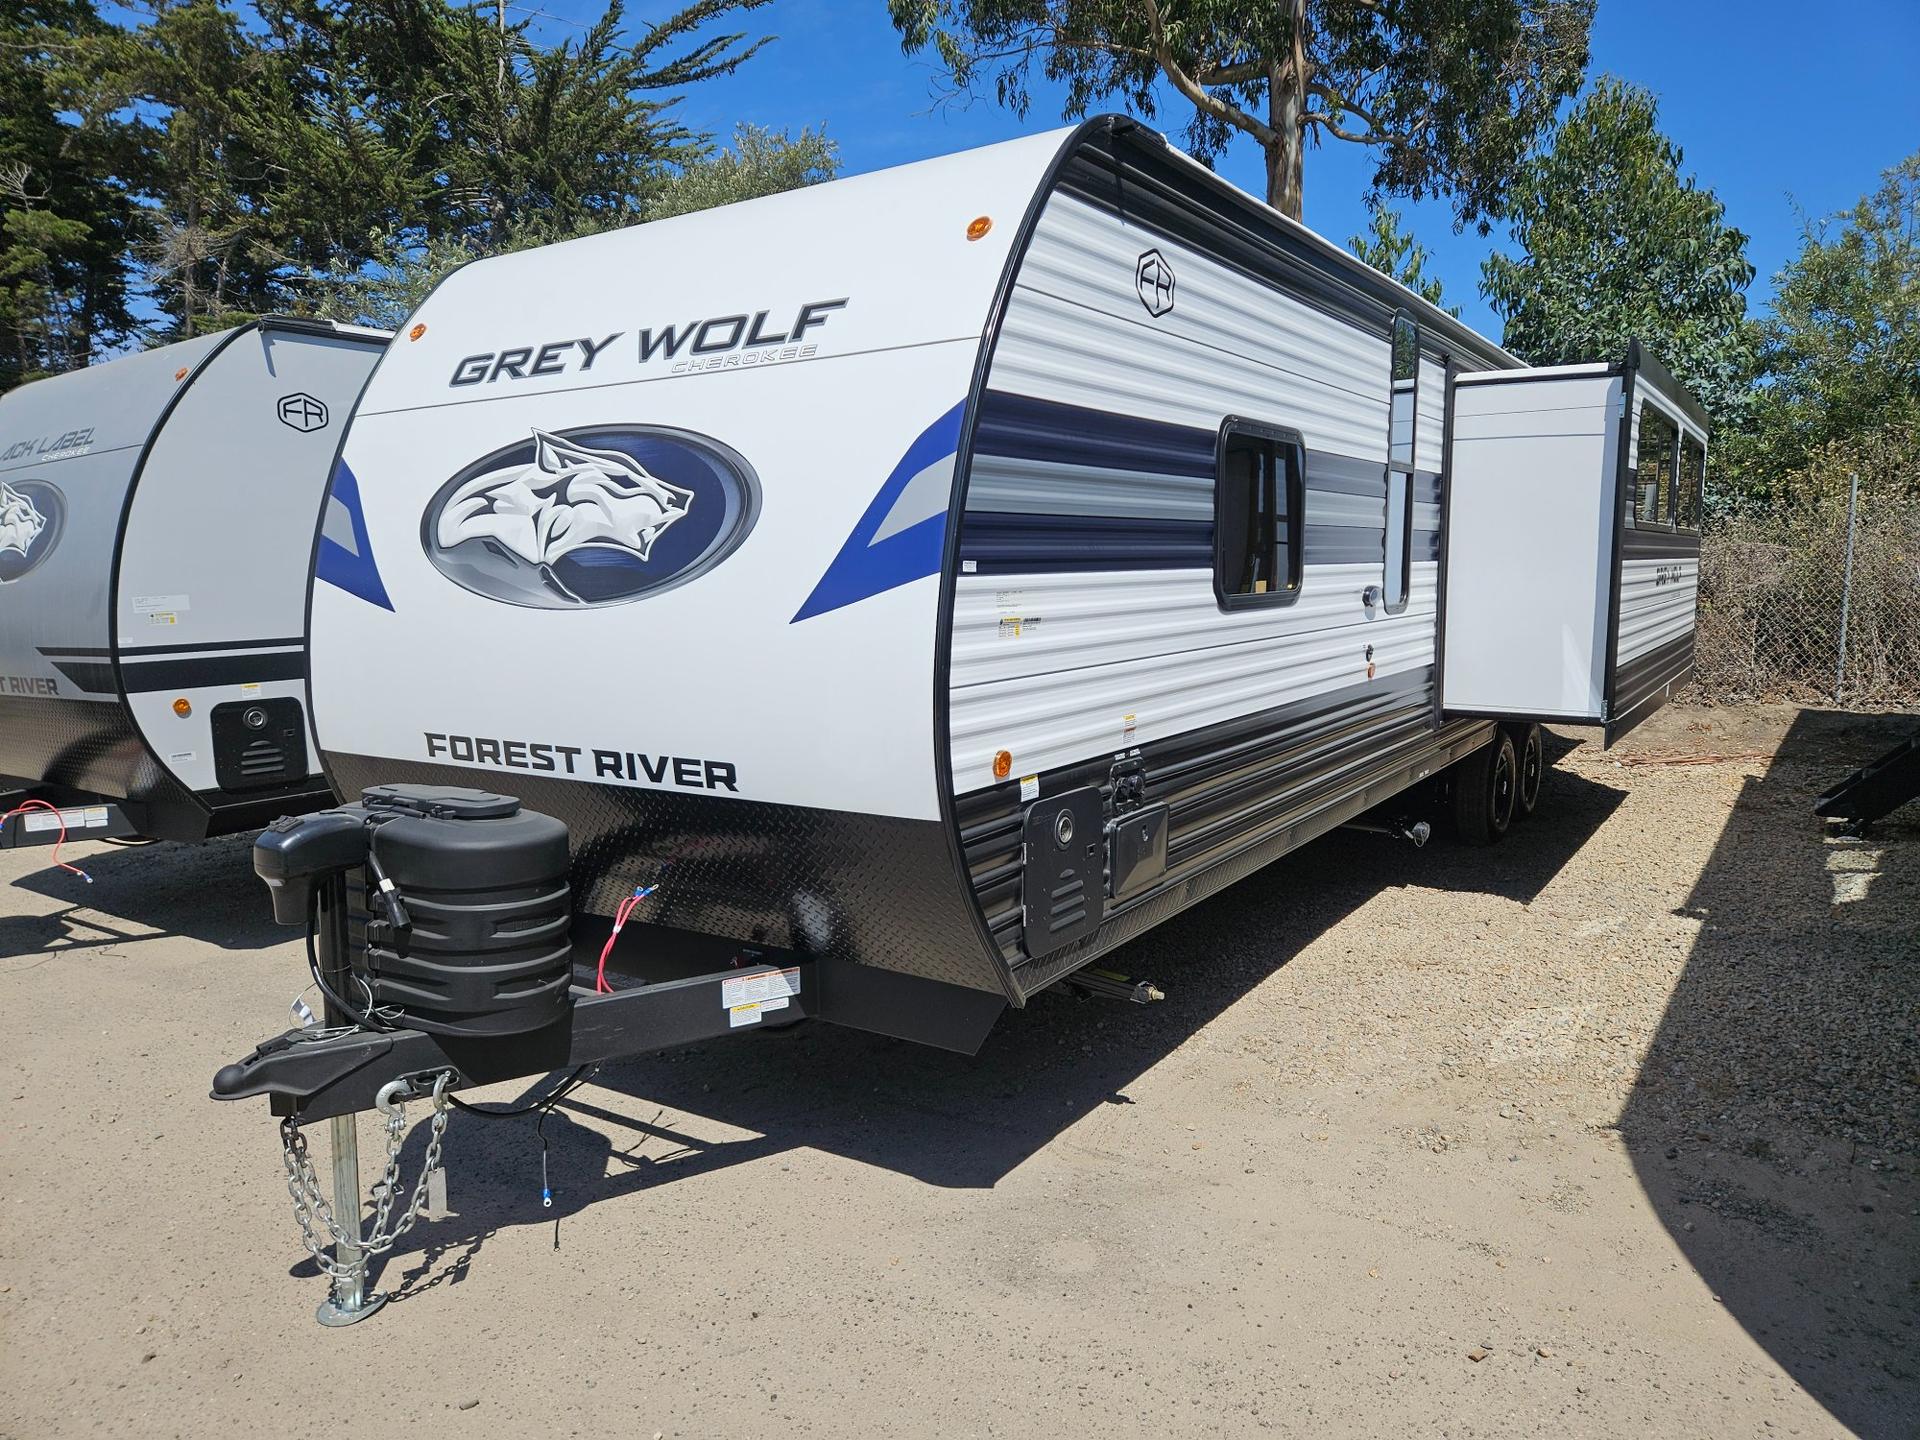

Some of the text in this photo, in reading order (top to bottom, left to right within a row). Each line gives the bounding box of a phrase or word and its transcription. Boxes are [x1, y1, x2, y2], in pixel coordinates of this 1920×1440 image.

[448, 297, 850, 388] GREY WOLF
[671, 344, 818, 374] CHEROKEE
[36, 427, 95, 455] LABEL
[8, 676, 60, 696] RIVER
[423, 732, 740, 792] FOREST RIVER
